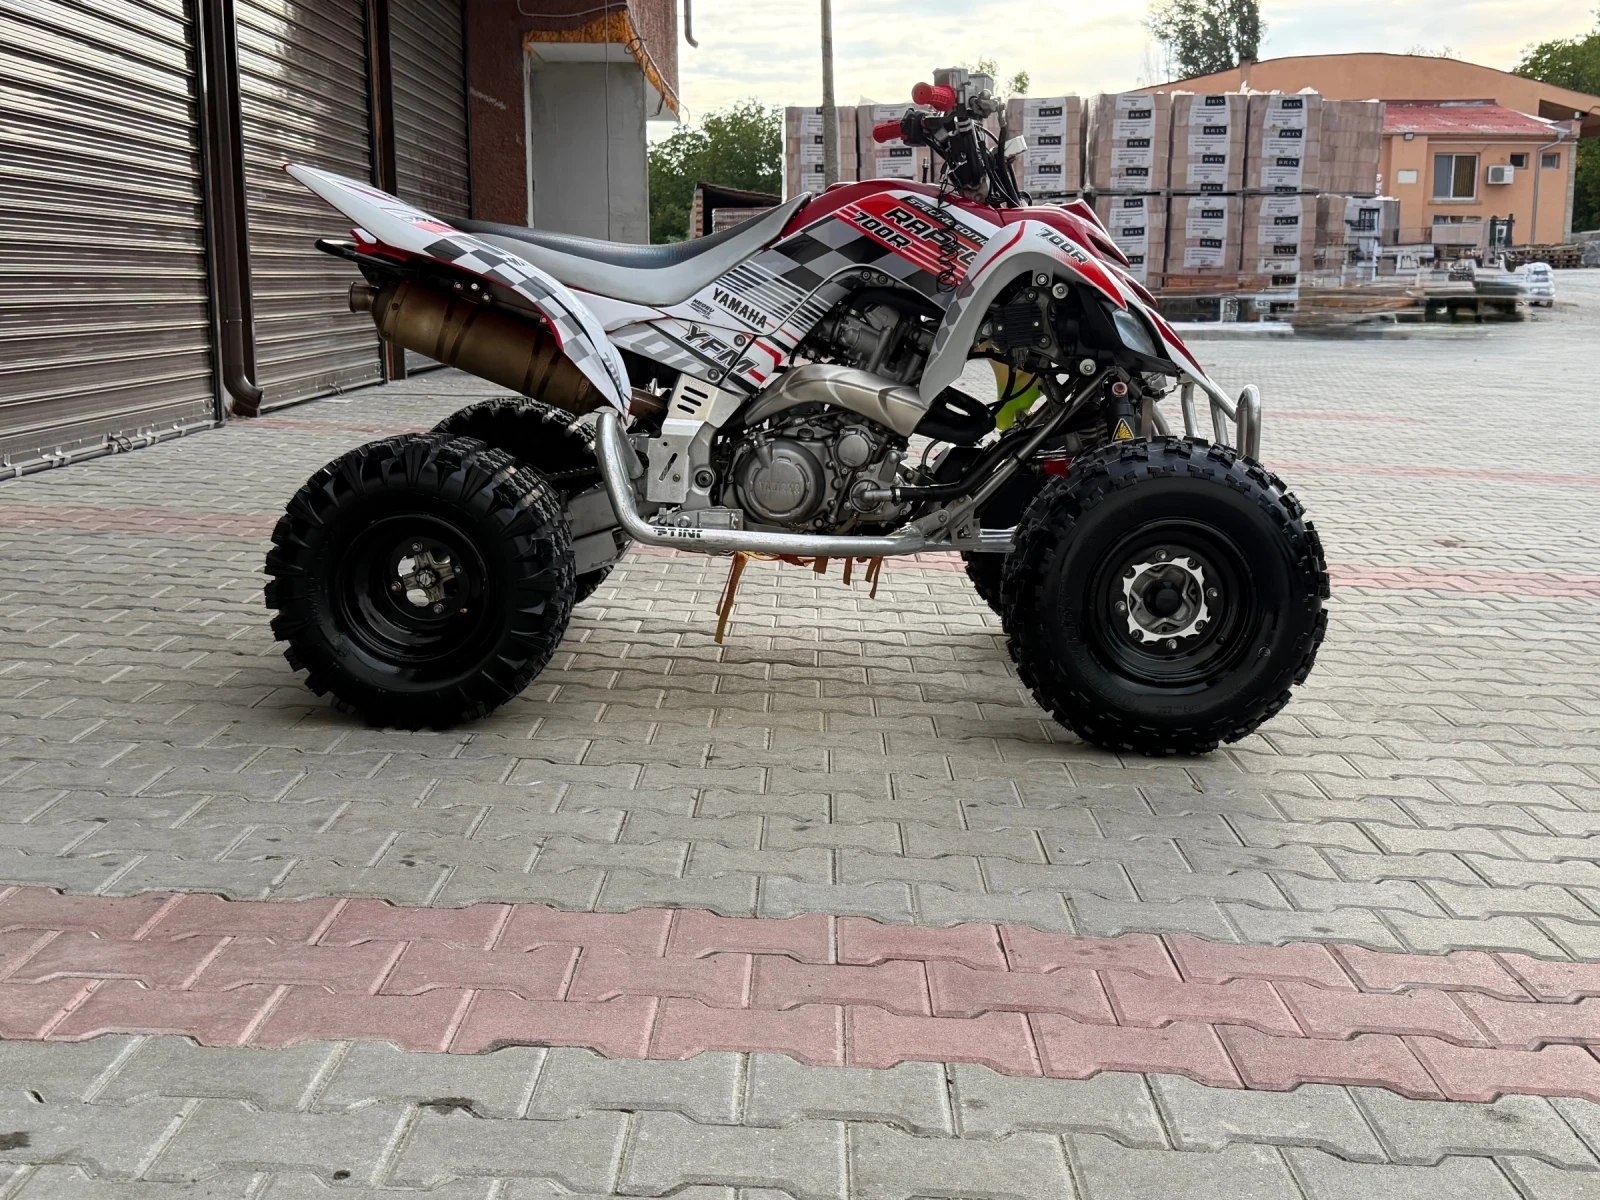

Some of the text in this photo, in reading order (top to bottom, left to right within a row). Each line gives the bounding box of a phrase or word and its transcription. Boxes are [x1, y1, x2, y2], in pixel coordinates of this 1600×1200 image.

[1040, 108, 1062, 116] BRIX
[850, 211, 912, 249] 700R
[1036, 227, 1088, 265] 700R
[712, 287, 768, 329] YAMAHA
[682, 322, 759, 375] YFM
